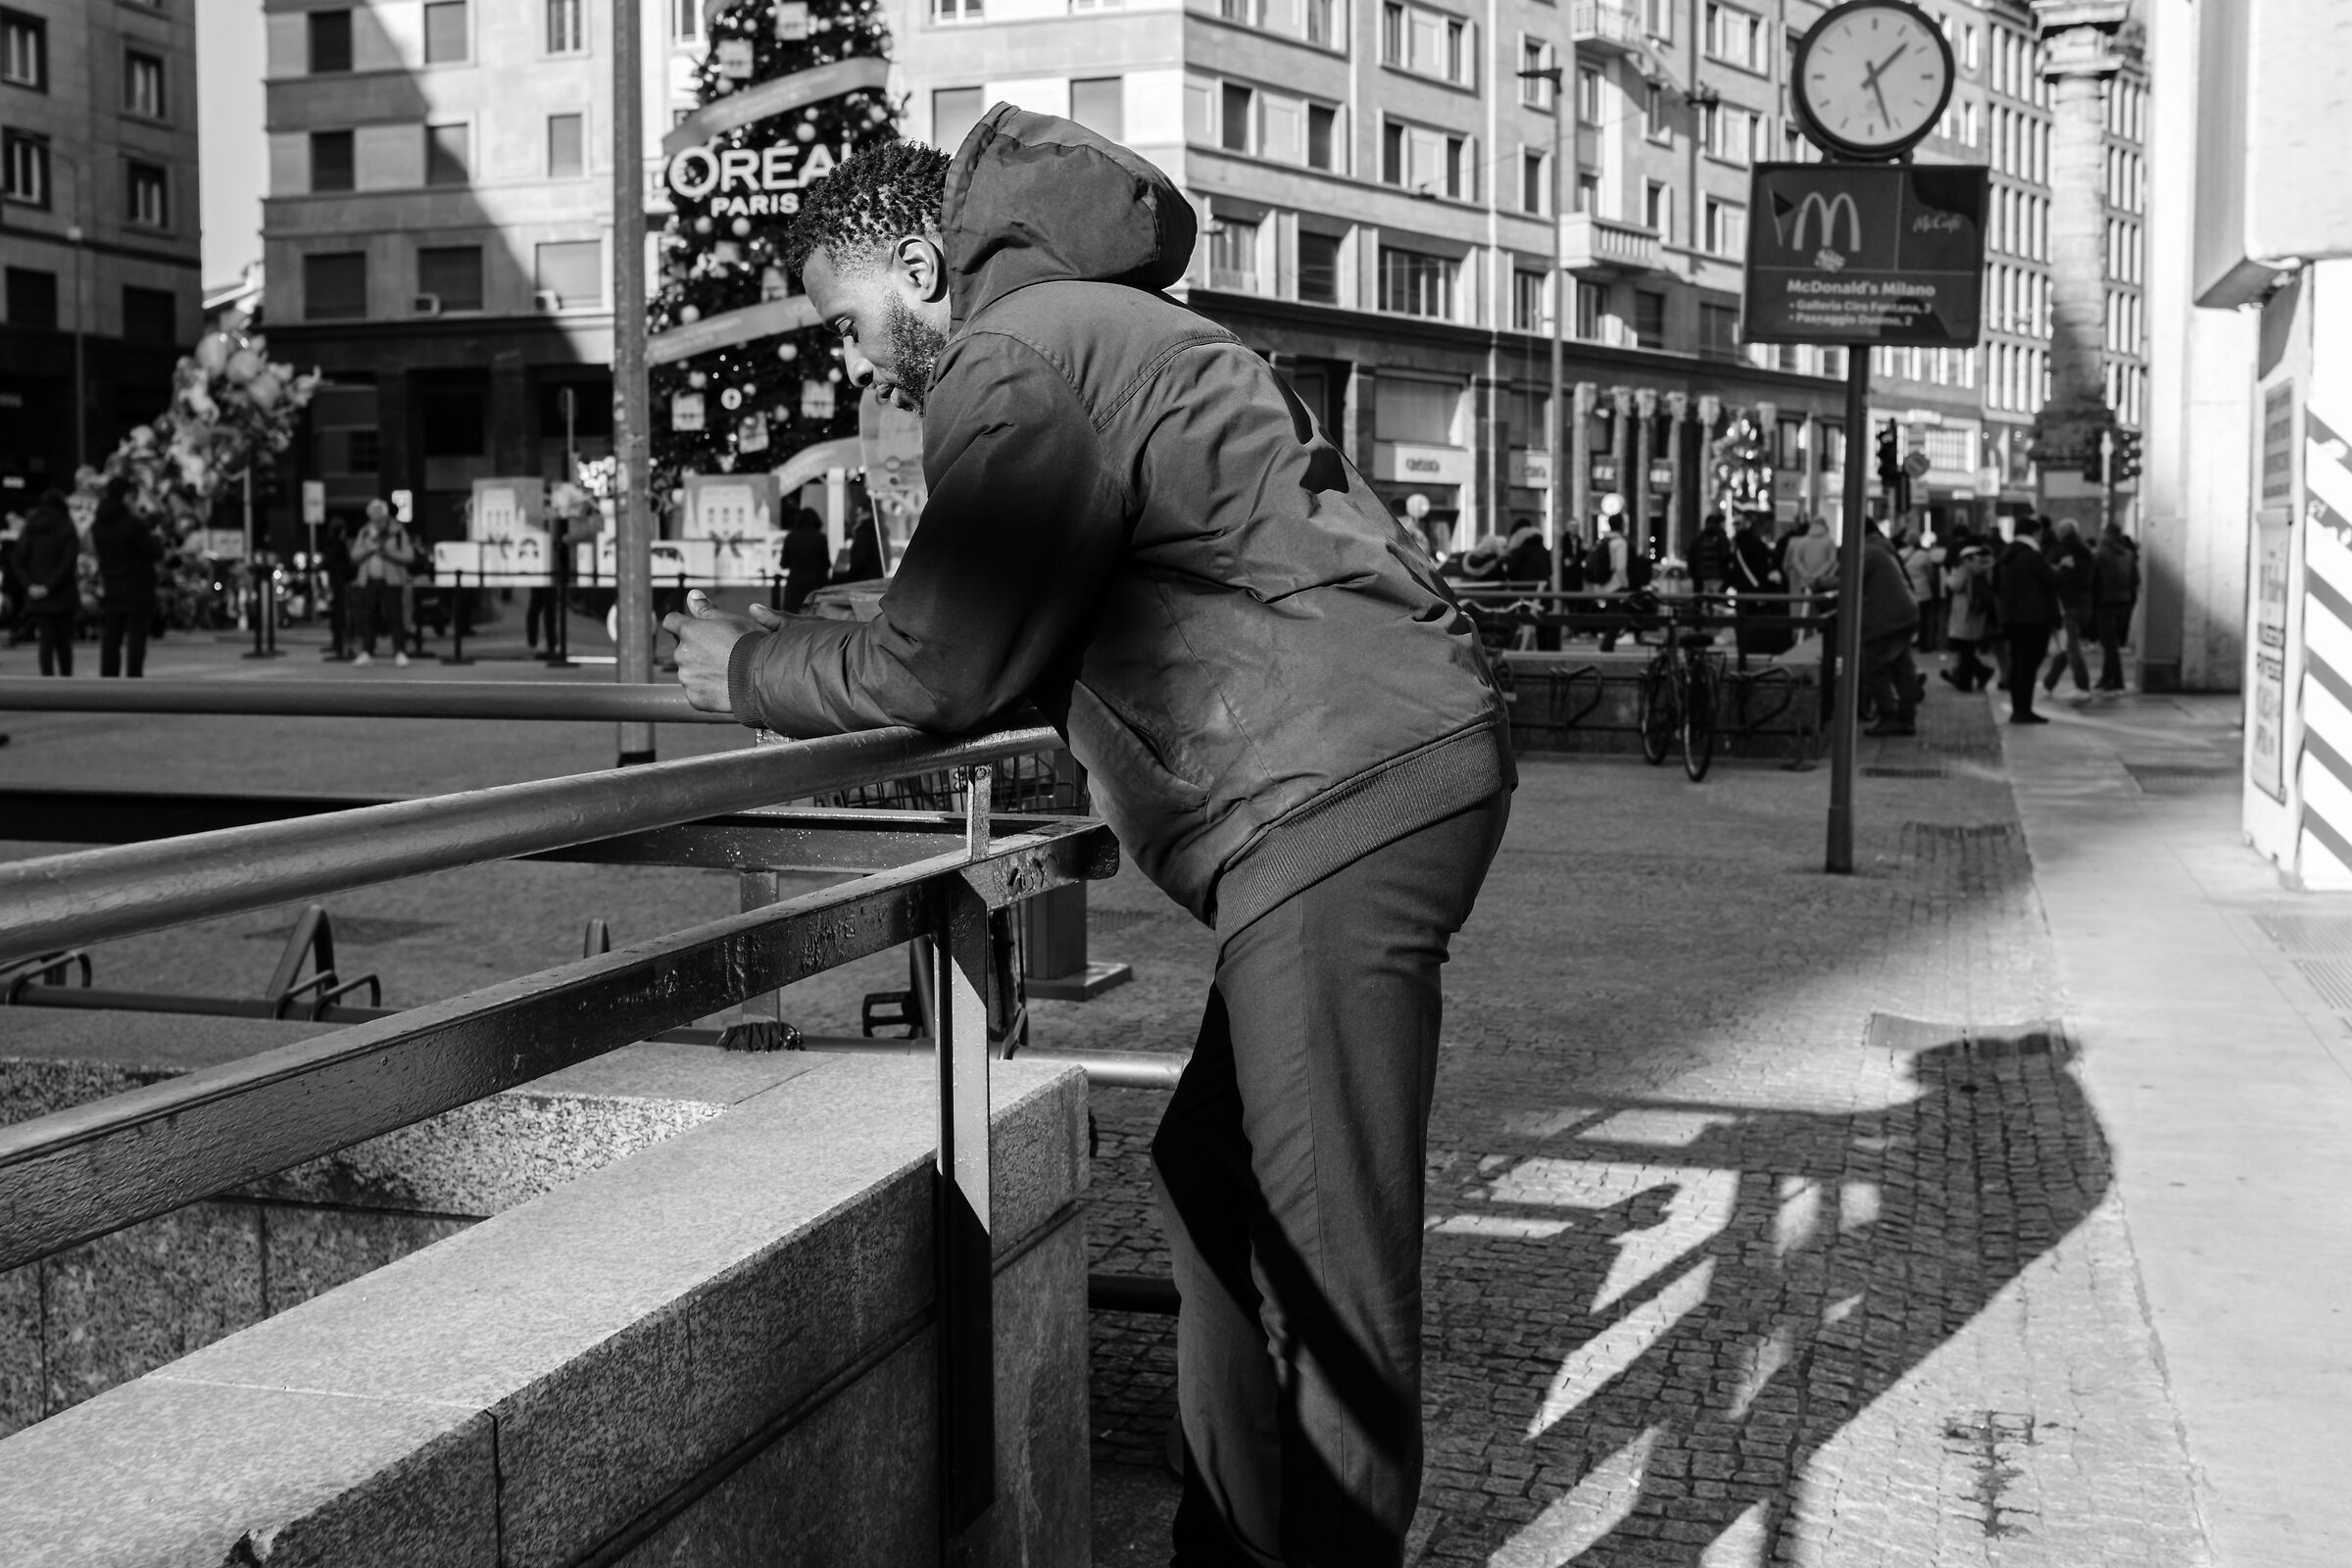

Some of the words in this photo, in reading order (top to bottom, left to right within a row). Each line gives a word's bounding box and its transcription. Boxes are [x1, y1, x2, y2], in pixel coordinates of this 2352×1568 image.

[710, 193, 799, 218] PARIS
[1787, 279, 1879, 296] McDonald's
[1881, 280, 1936, 297] Milano
